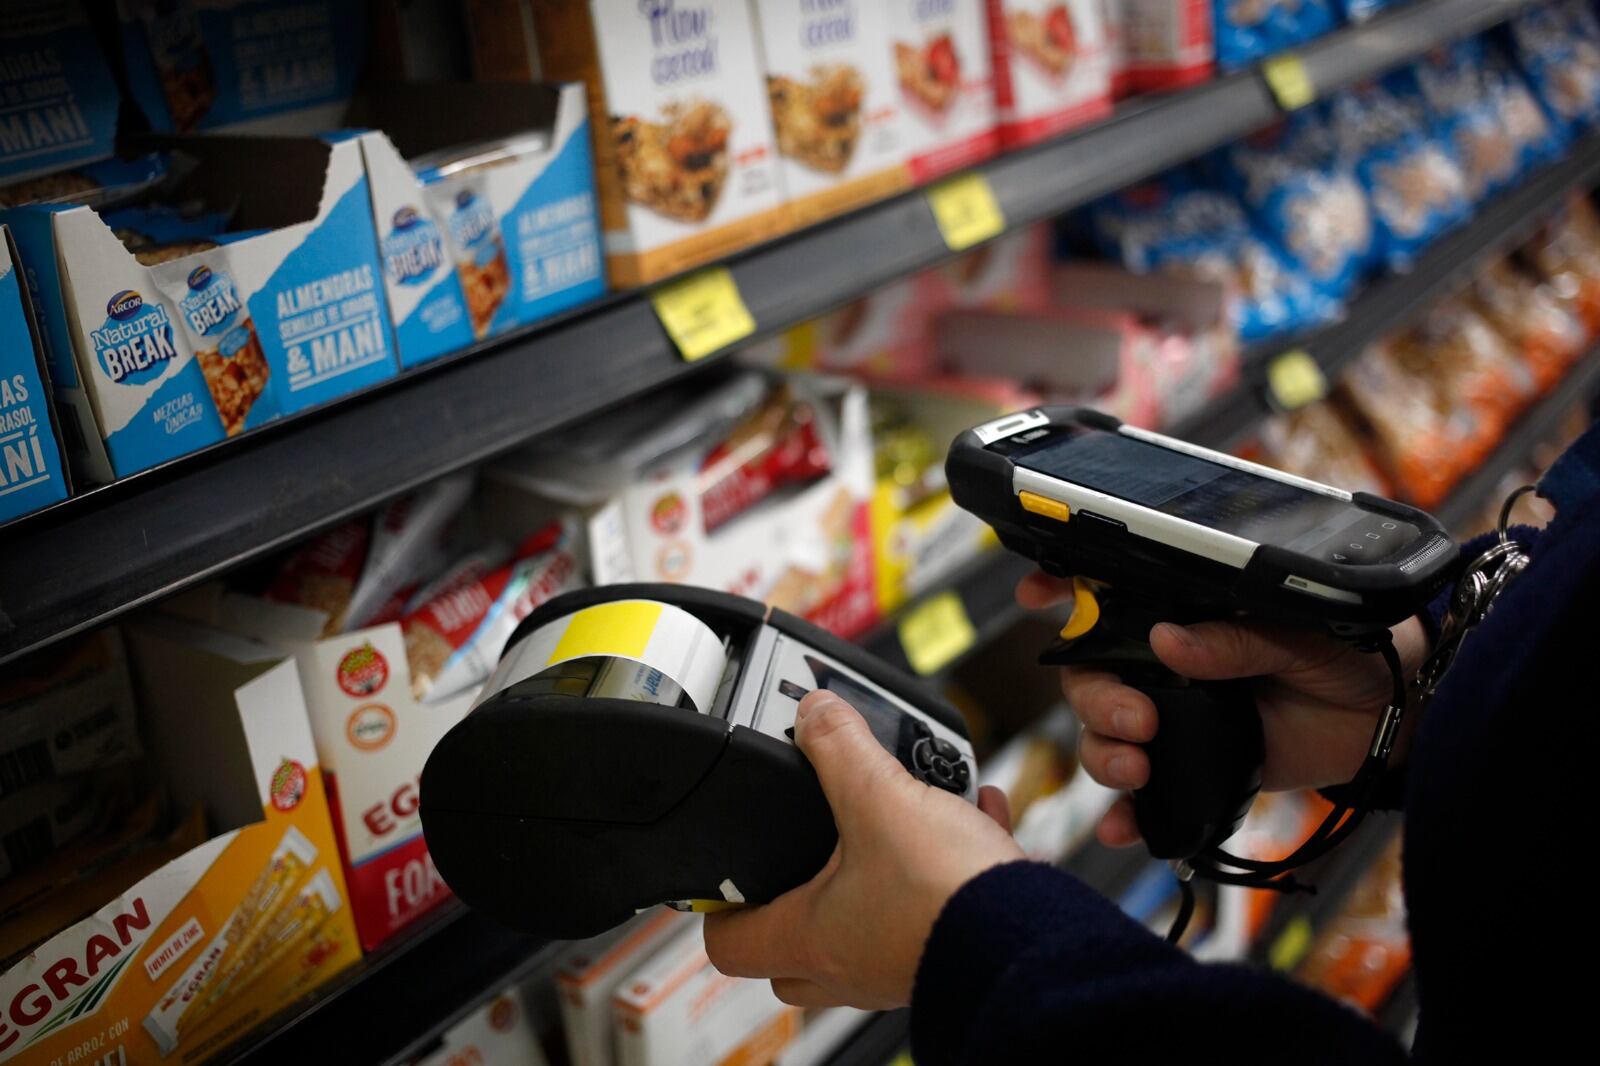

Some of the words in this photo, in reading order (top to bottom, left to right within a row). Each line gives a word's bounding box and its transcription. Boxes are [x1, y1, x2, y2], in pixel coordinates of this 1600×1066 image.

[109, 296, 142, 315] ARCOR
[190, 287, 242, 336] BREAK
[277, 264, 374, 319] ALMENDRAS
[90, 304, 168, 351] Natural
[102, 326, 176, 383] BREAK
[287, 345, 310, 374] &
[311, 312, 384, 375] MANÍ
[362, 772, 420, 837] EG
[181, 947, 221, 1002] EGRAN
[67, 1032, 104, 1066] ARROZ
[109, 1016, 129, 1040] CON
